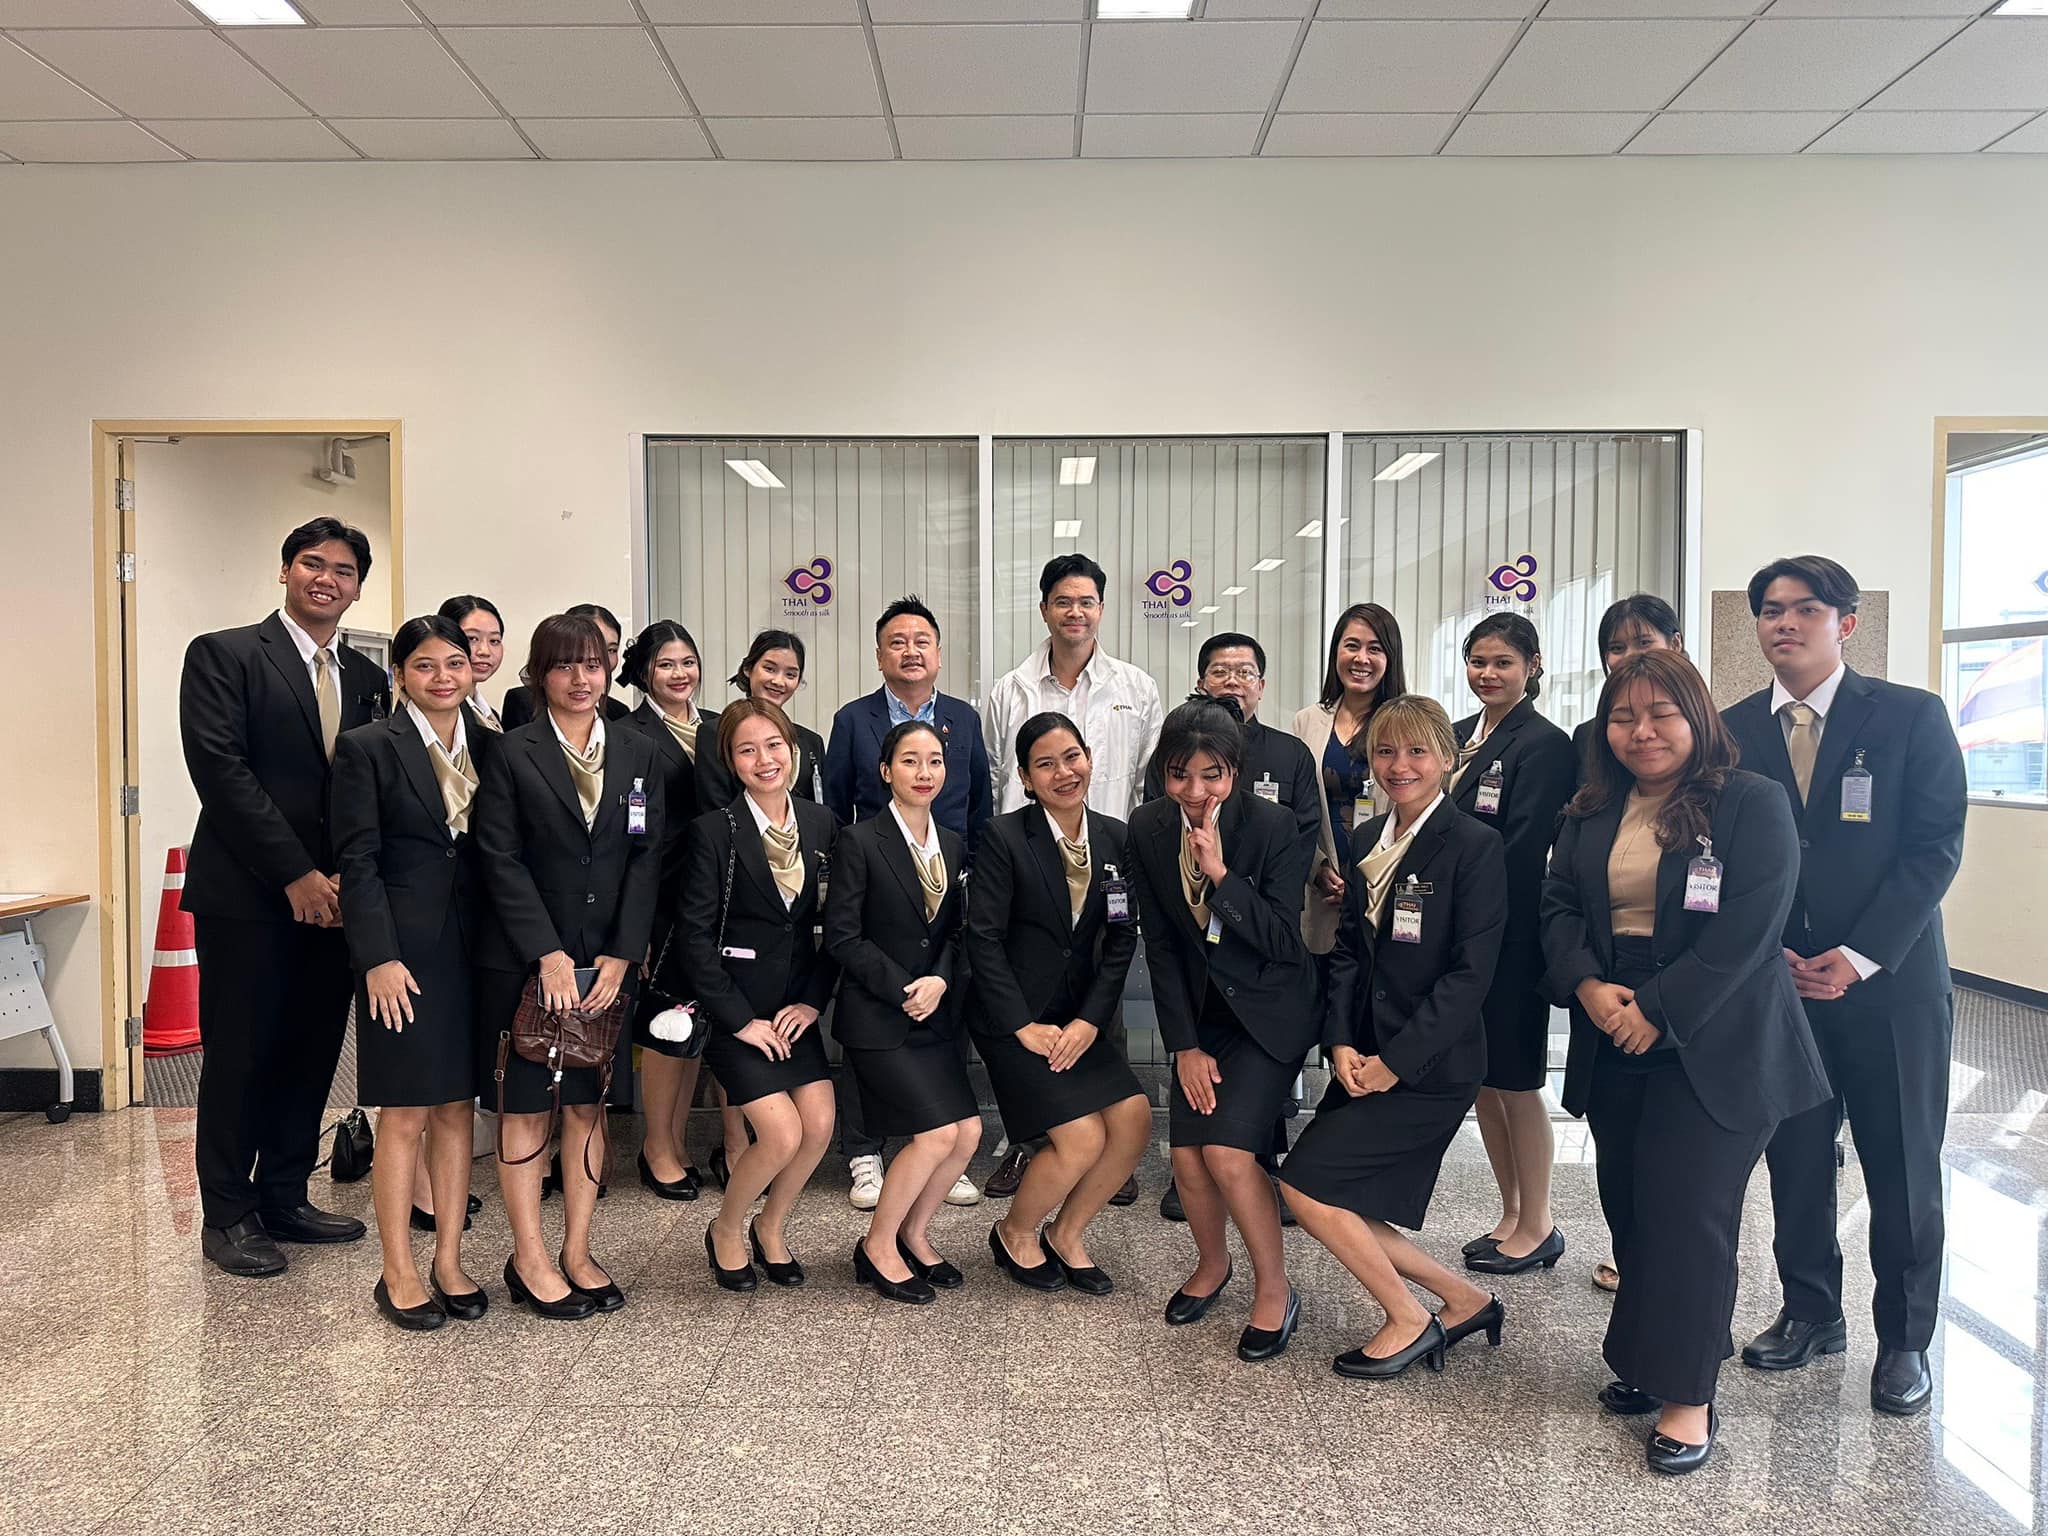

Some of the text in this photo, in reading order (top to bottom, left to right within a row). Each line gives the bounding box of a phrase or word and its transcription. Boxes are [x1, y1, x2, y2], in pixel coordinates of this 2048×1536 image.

[782, 598, 807, 606] THAI
[1485, 595, 1511, 604] THAI
[1141, 600, 1167, 608] THAI
[819, 608, 830, 616] silk
[1143, 611, 1168, 619] Smooth
[1180, 610, 1191, 618] silk
[1395, 916, 1420, 924] VISITOR
